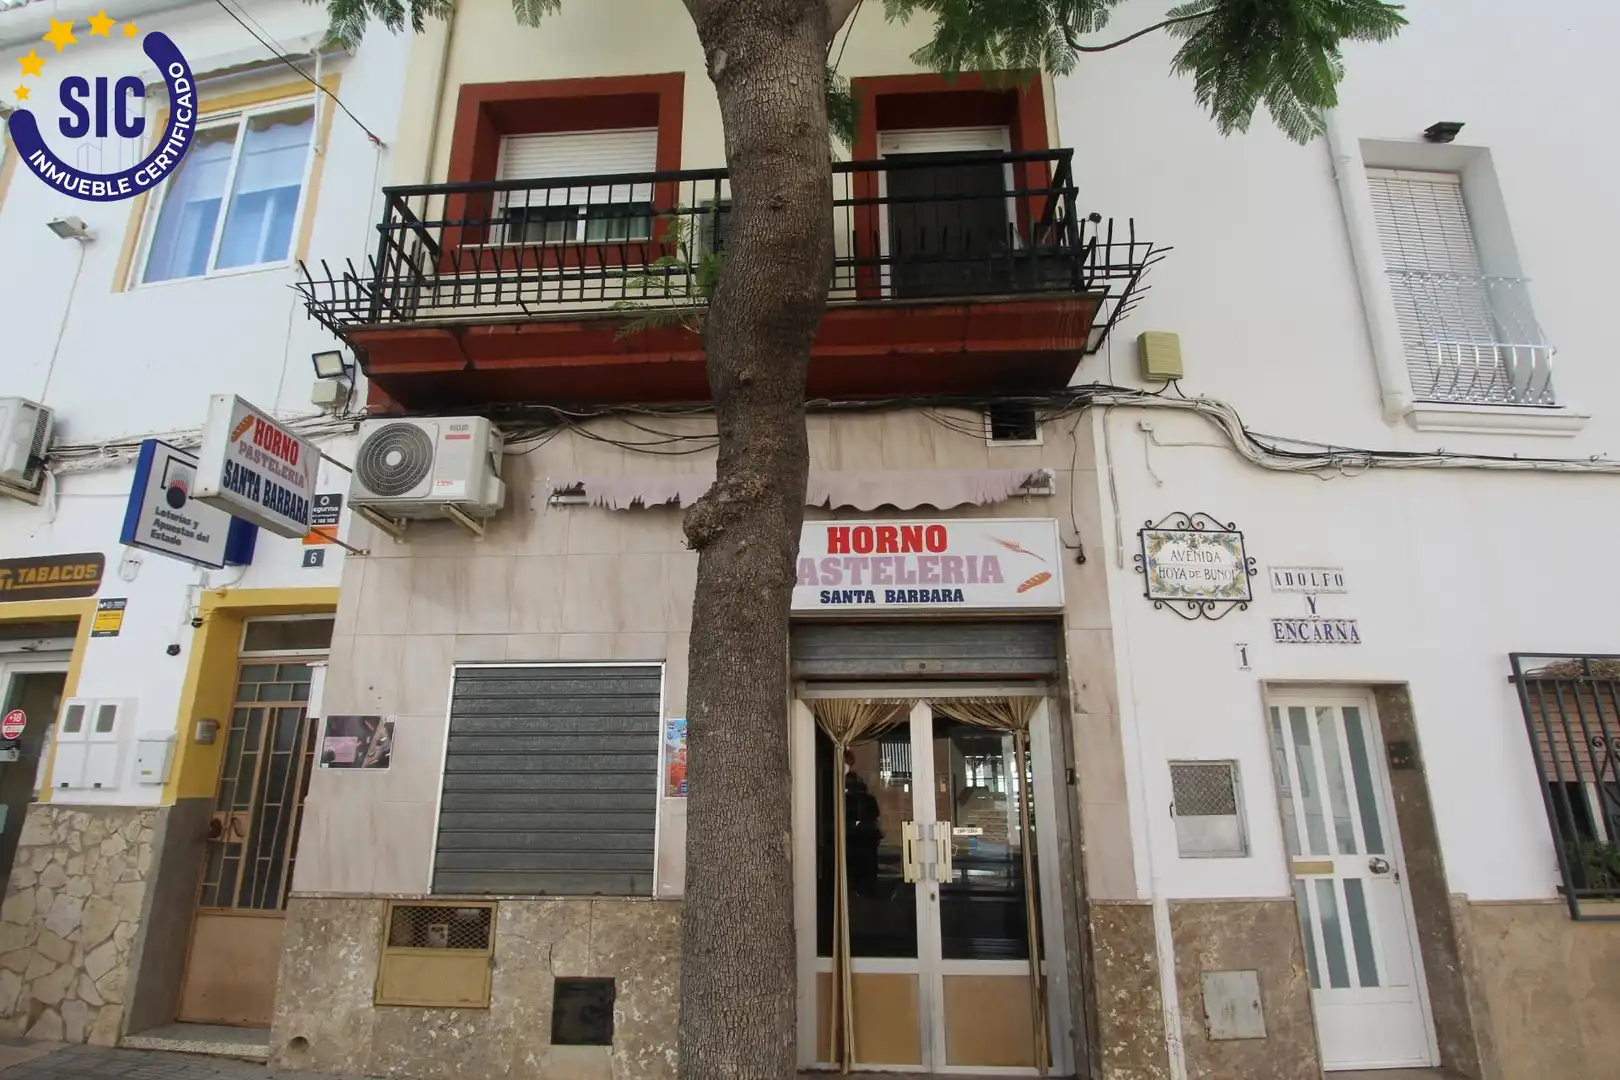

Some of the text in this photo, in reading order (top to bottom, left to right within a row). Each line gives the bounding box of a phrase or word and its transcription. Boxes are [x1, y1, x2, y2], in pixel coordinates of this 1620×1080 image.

[252, 417, 300, 466] HORNO
[238, 440, 305, 489] PASTELERIA
[223, 458, 310, 527] SANTA BARBARA
[153, 518, 210, 544] Apuestas del
[193, 521, 200, 530] y
[150, 529, 182, 546] Estado
[826, 524, 948, 555] HORNO
[310, 552, 318, 564] 6
[1170, 549, 1222, 563] AVENIDA
[18, 564, 99, 583] TABACOS
[797, 555, 1004, 586] ASTELERIA
[1159, 566, 1187, 580] HOYA
[1189, 570, 1202, 579] DE
[1273, 571, 1344, 587] ADOLFO
[819, 588, 965, 604] SANTA BARBARA
[1306, 595, 1318, 615] Y
[1273, 622, 1360, 641] ENCARNA
[1239, 646, 1249, 667] 1
[8, 712, 23, 723] +18
